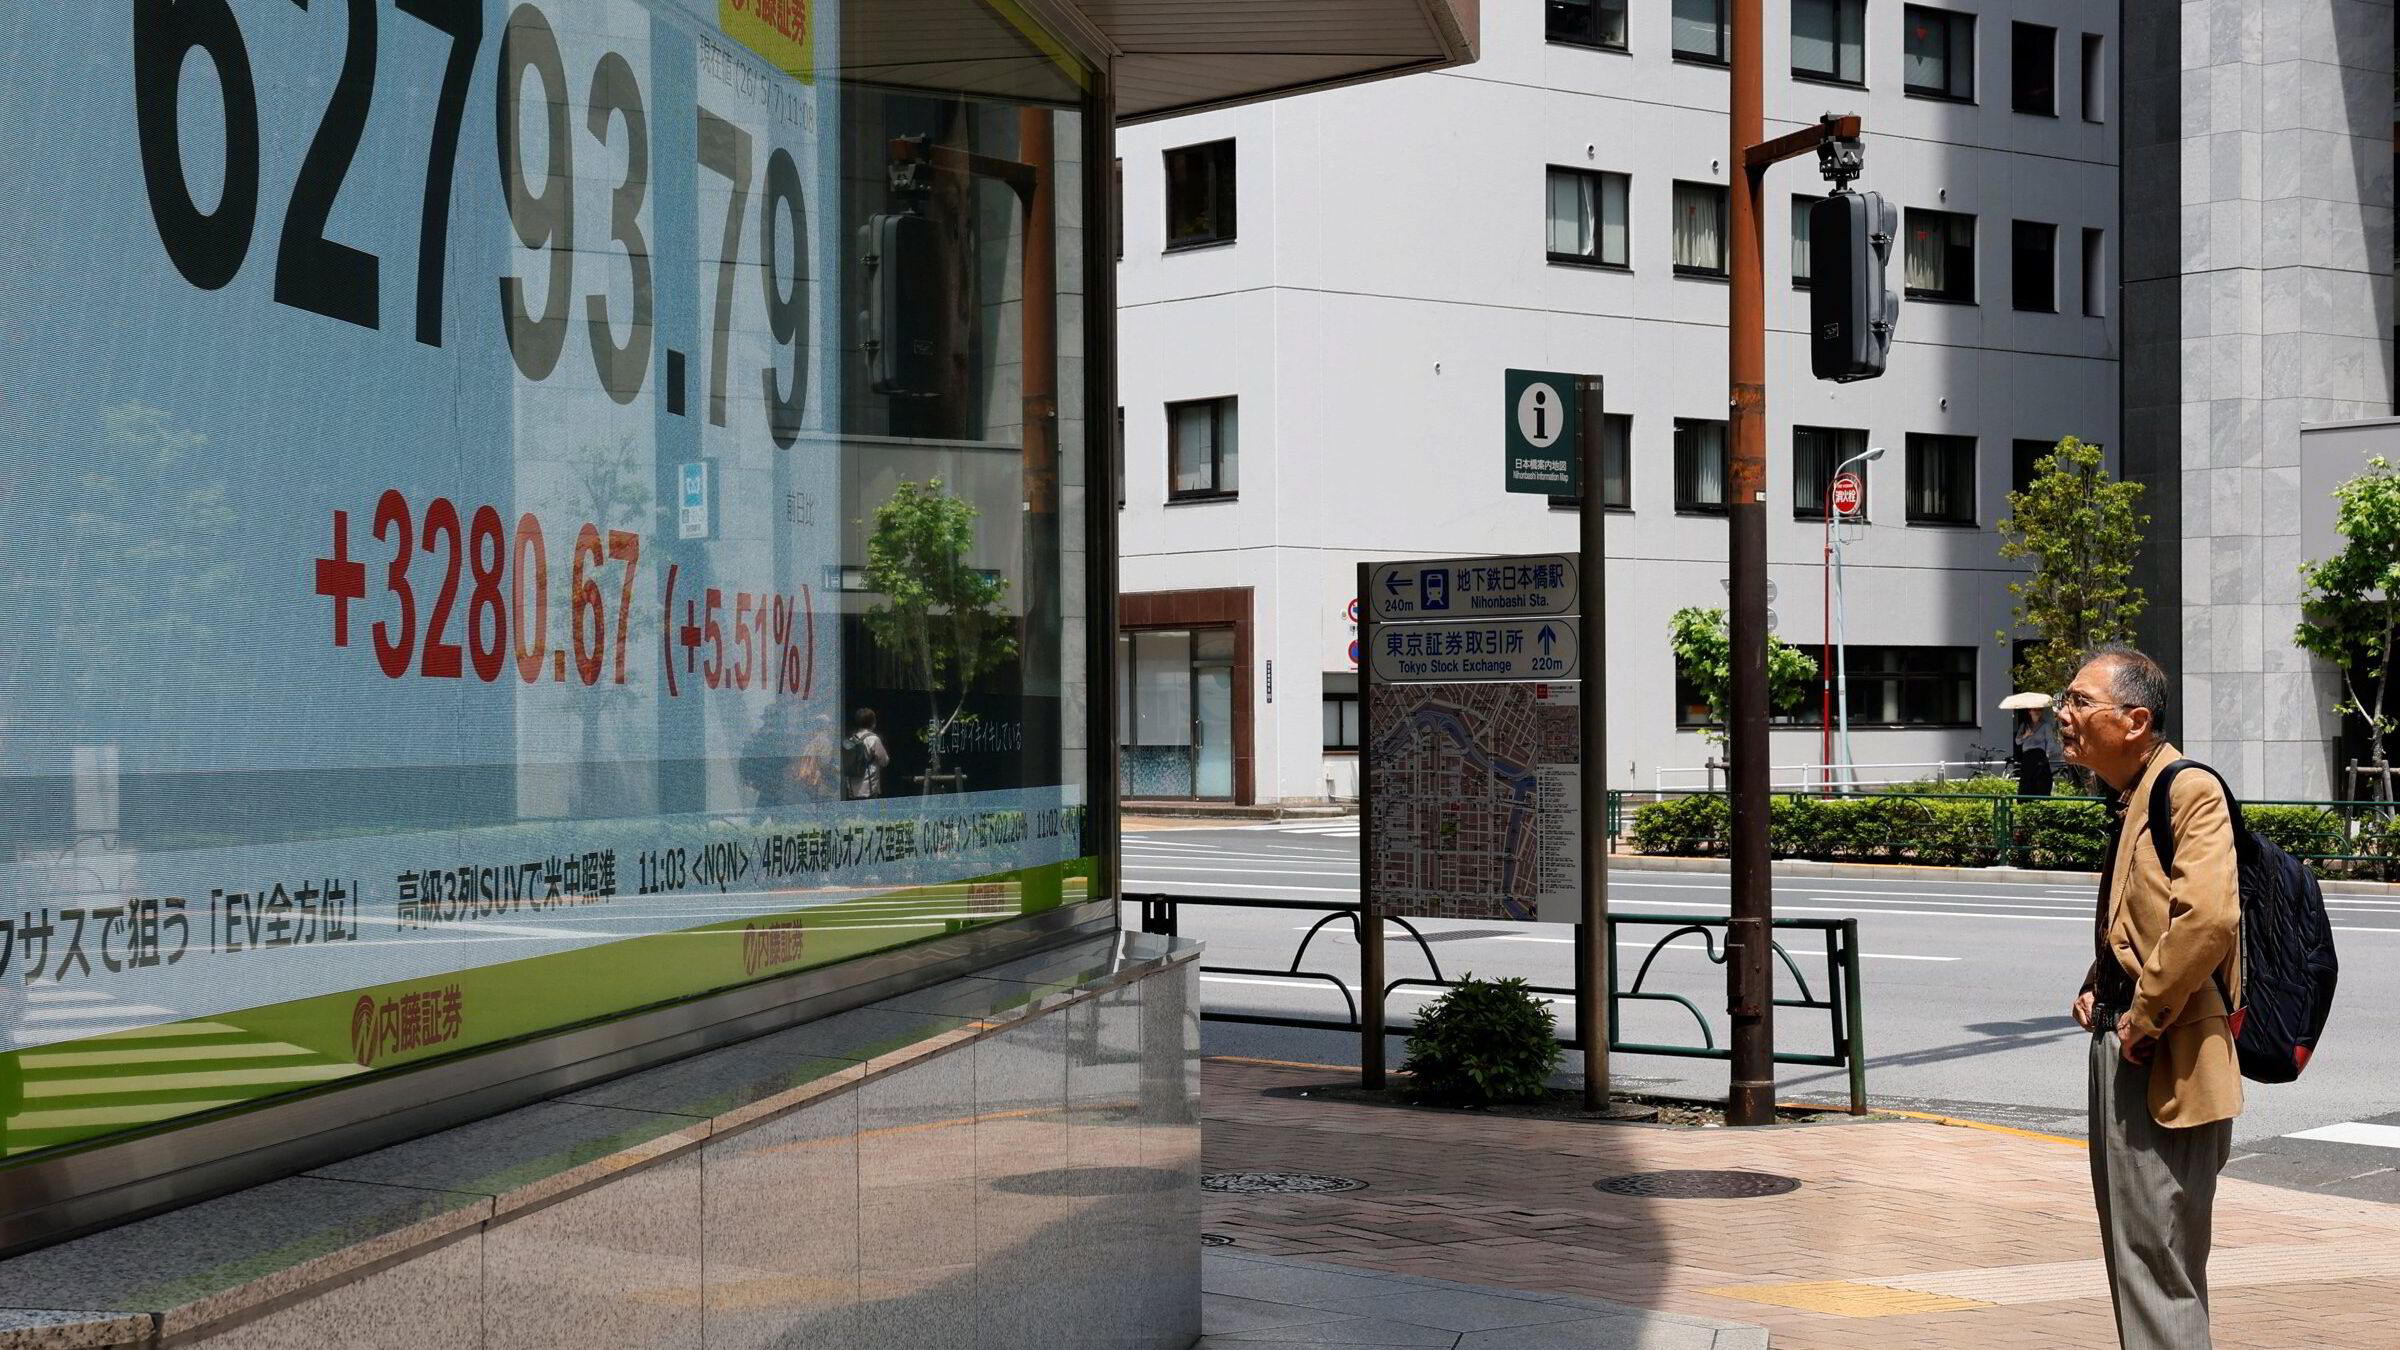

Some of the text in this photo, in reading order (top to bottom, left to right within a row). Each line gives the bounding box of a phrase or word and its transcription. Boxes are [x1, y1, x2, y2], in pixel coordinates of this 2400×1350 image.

[134, 0, 811, 450] 62793.79
[1515, 458, 1567, 472] 日本橋案内地図
[1456, 564, 1565, 592] 地下鉄日本橋駅
[315, 489, 813, 700] +3280.67 (+5.51%)
[1385, 599, 1414, 612] 240m
[1471, 593, 1549, 609] Nihonbashi Sta.
[1386, 629, 1523, 657] 東京証券取引所
[1399, 659, 1512, 675] Tokyo Stock Exchange
[1532, 657, 1563, 671] 220m
[639, 848, 686, 894] 11:03
[380, 984, 462, 1057] 内藤証券
